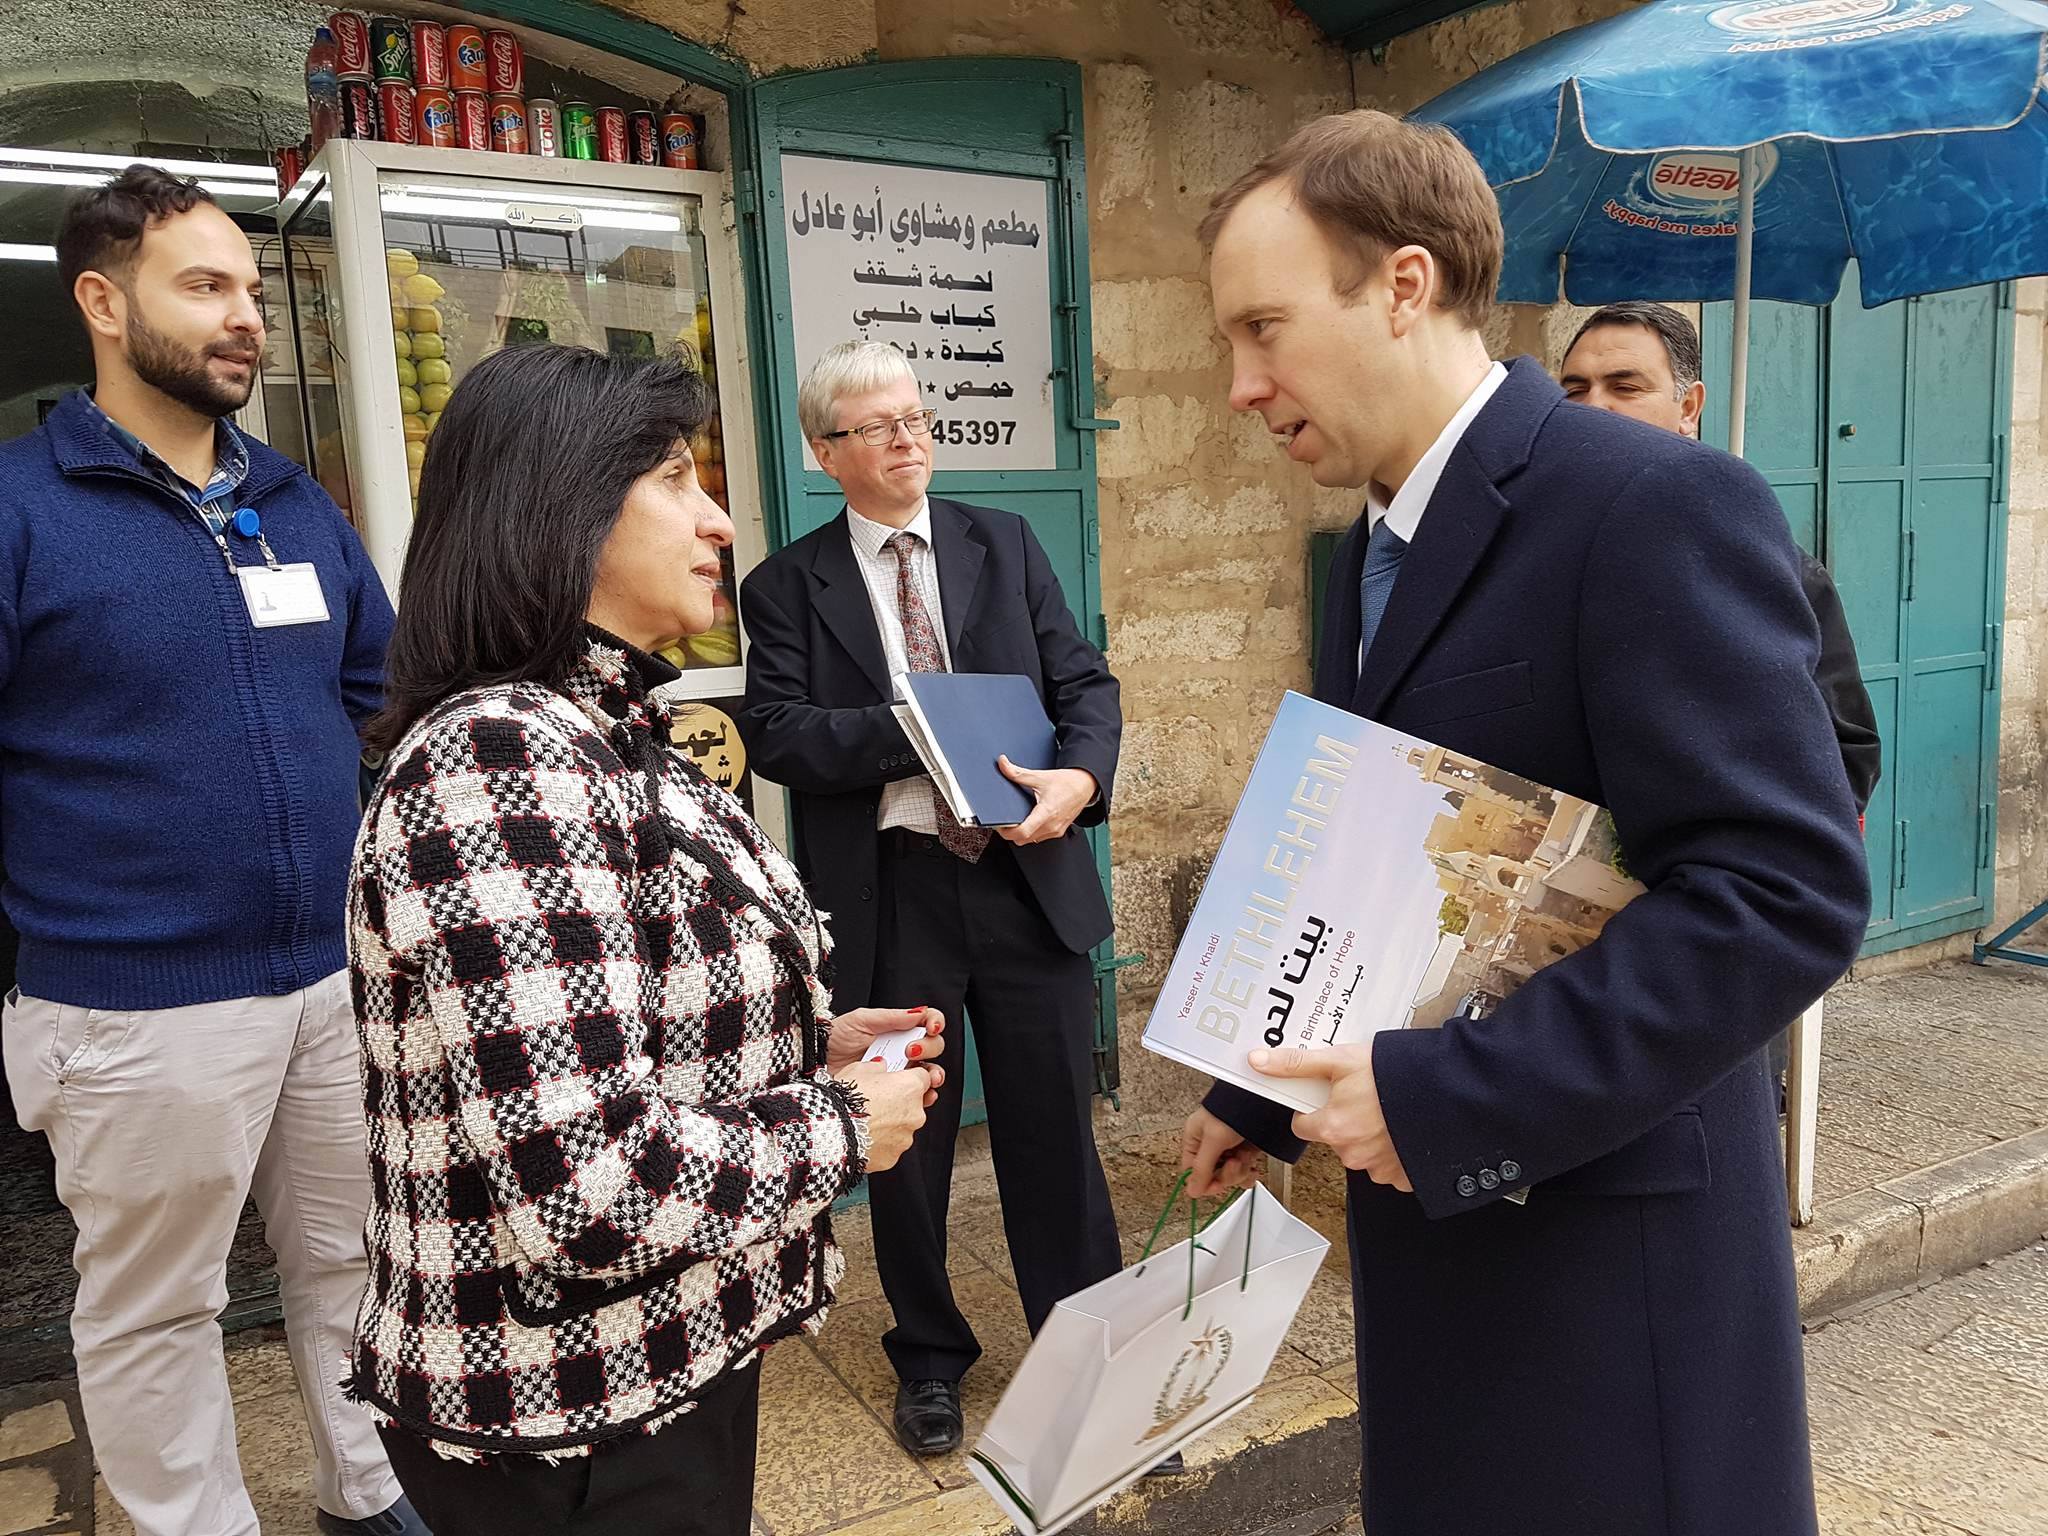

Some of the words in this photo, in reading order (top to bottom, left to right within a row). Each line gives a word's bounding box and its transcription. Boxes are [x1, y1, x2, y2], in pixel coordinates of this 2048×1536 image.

[367, 99, 376, 125] zero
[507, 207, 526, 220] الله
[792, 189, 847, 236] عادل
[851, 184, 884, 242] أبو
[889, 201, 976, 254] ومشاوي
[981, 208, 1041, 254] مطعم
[853, 258, 924, 288] شقف
[929, 263, 994, 292] لحمة
[852, 299, 923, 333] حلبي
[929, 303, 997, 333] كباب
[940, 338, 1005, 369] كبدة
[944, 379, 1015, 402] حمص
[1196, 734, 1360, 1045] BETHLEHEM
[1199, 932, 1220, 968] Khaldi
[1279, 915, 1334, 985] بيت
[1333, 929, 1357, 964] Hope
[1193, 971, 1206, 983] M.
[1329, 963, 1341, 979] of
[1341, 963, 1364, 1005] ميلاد
[1177, 983, 1200, 1019] Yasser
[1300, 980, 1334, 1042] Birthplace
